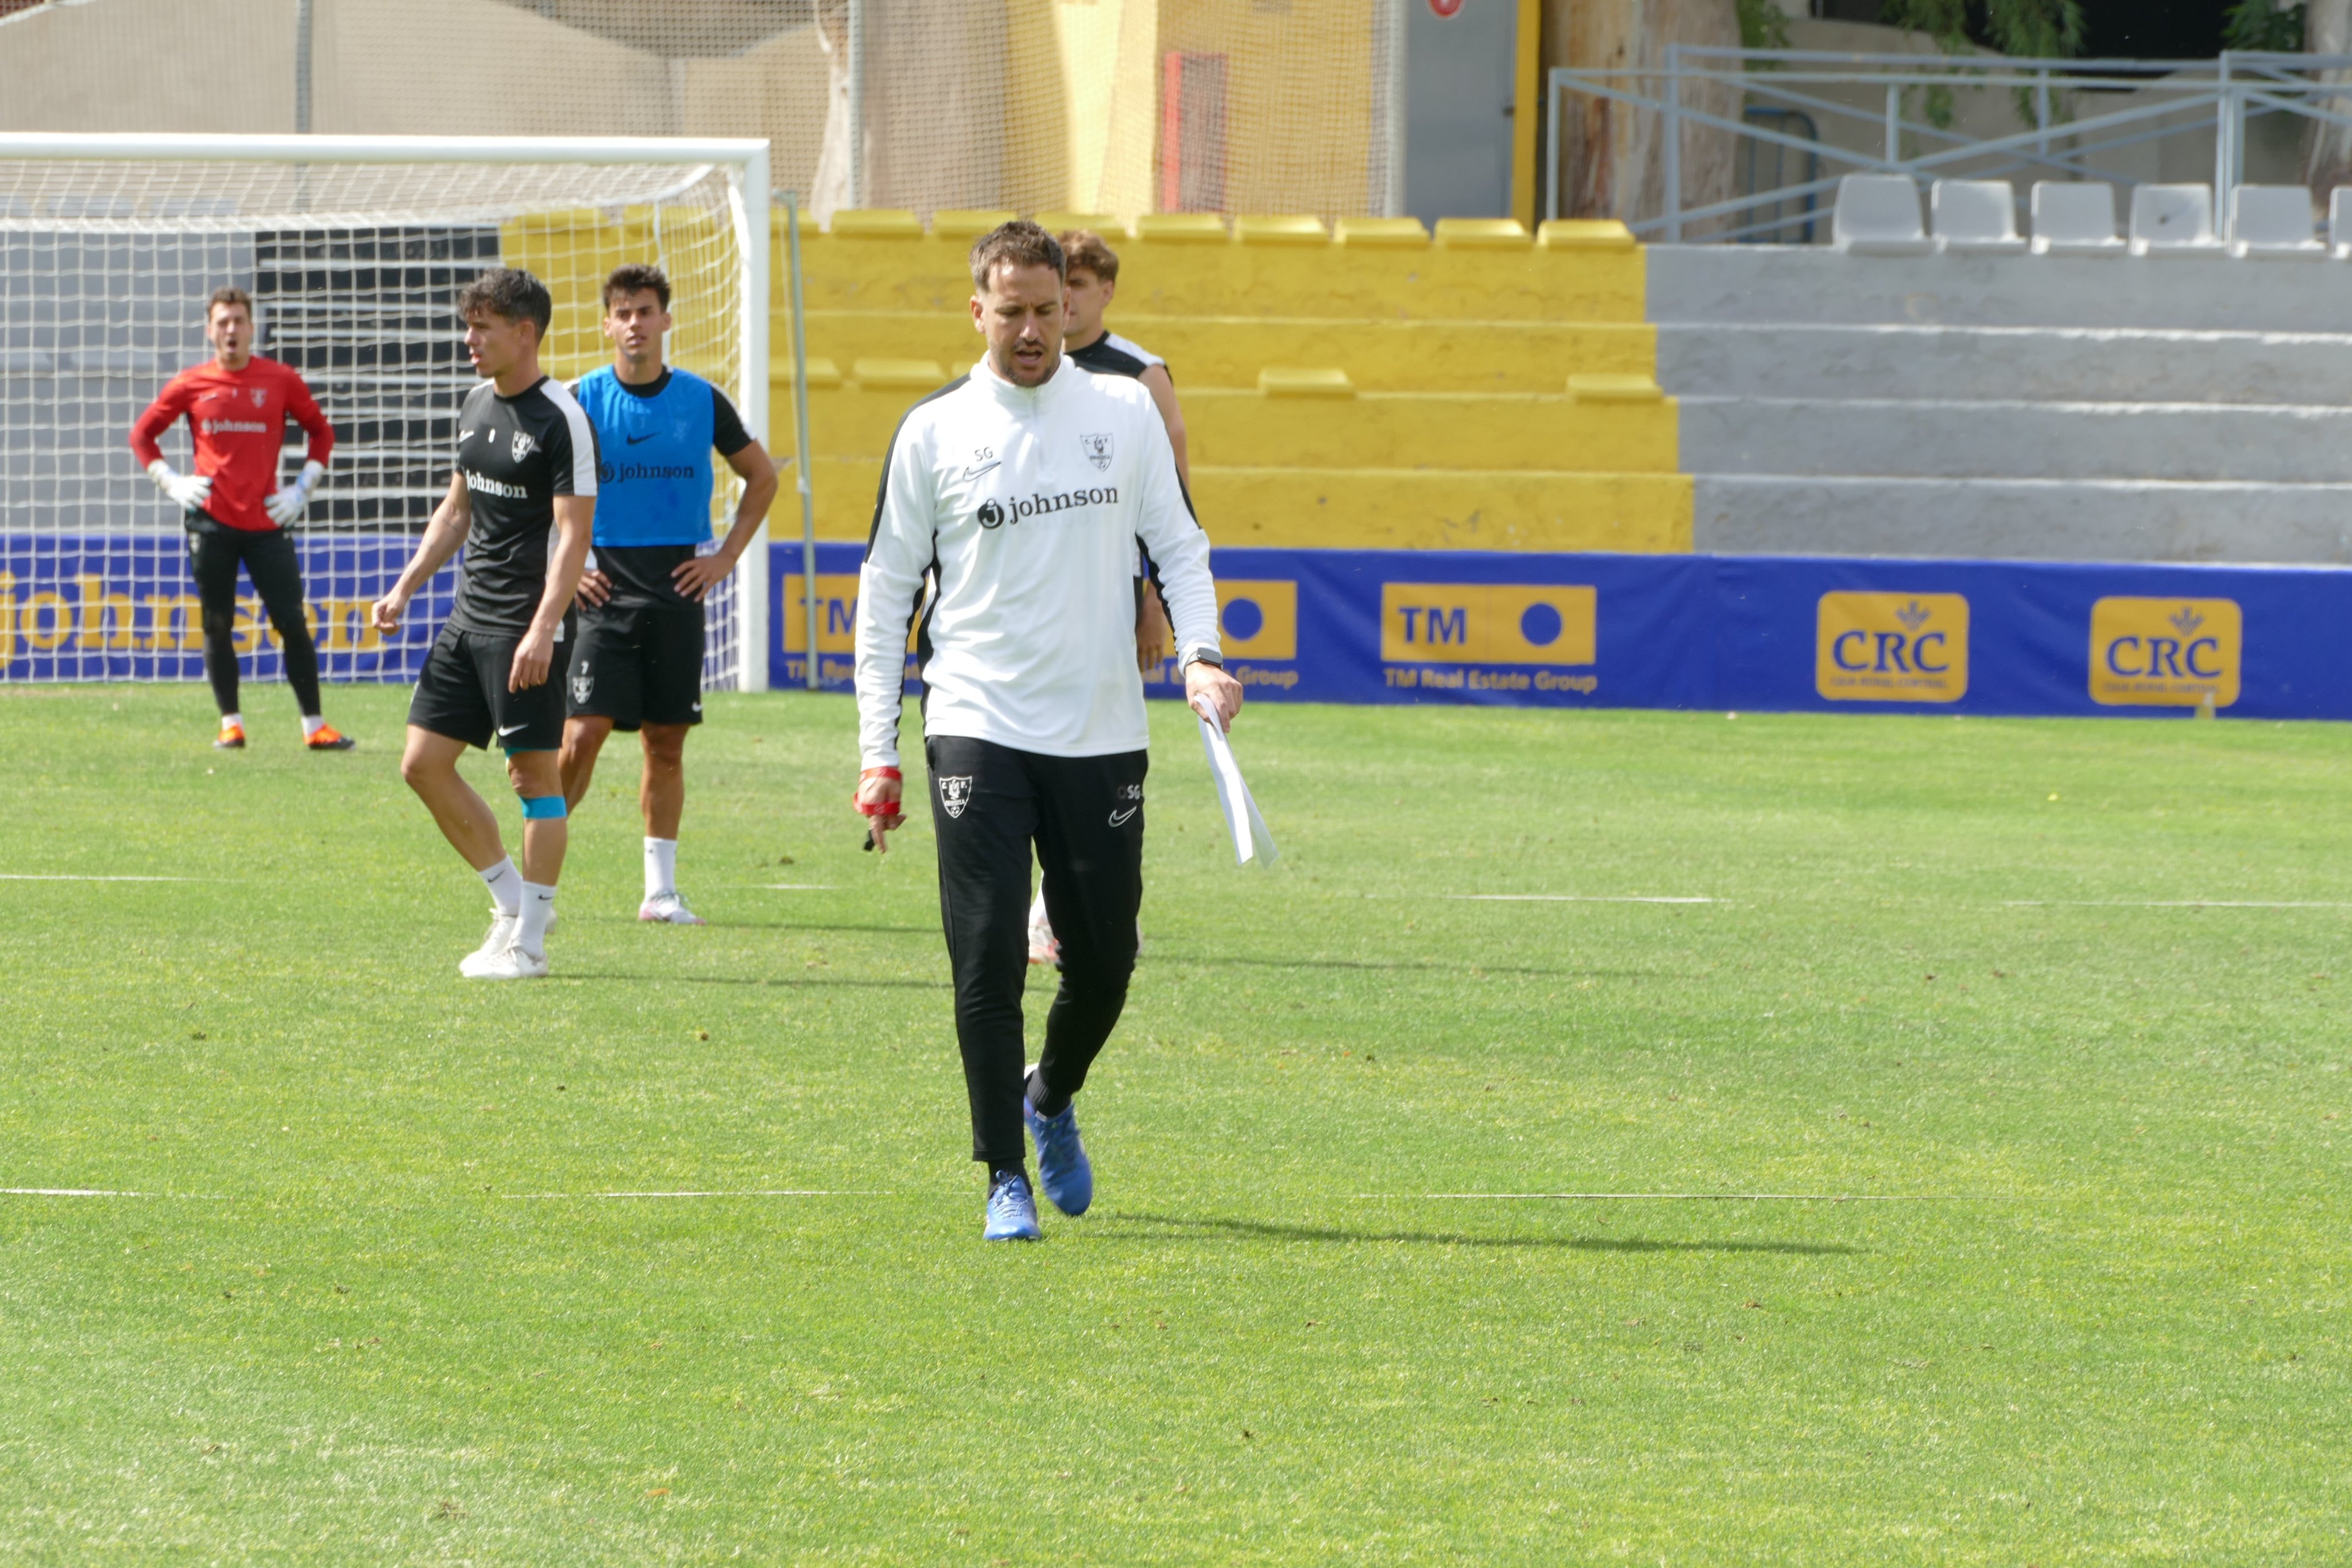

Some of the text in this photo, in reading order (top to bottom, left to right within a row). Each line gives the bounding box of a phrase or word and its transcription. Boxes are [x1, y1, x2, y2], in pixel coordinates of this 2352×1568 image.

[974, 447, 993, 461] SG
[617, 463, 695, 483] johnson
[1008, 487, 1119, 525] johnson
[1398, 607, 1466, 644] TM
[1832, 630, 1949, 674] CRC
[2105, 636, 2222, 679] CRC
[1236, 665, 1298, 690] Group
[1383, 668, 1597, 696] TM Real Estate Group
